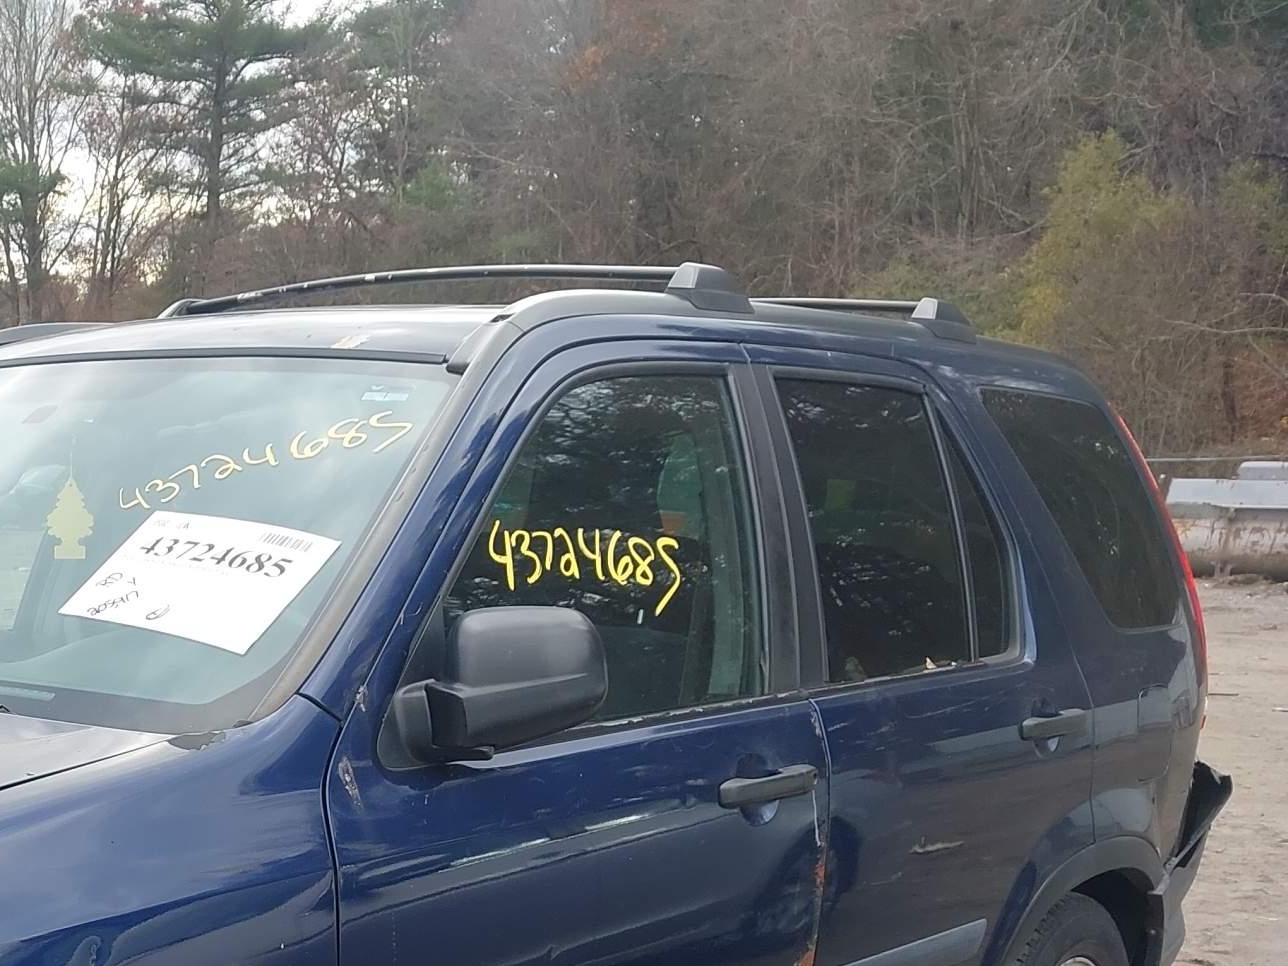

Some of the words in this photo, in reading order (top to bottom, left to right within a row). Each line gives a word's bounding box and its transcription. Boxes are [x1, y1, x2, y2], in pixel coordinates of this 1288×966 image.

[119, 411, 413, 511] 43724685
[140, 537, 293, 577] 43724685
[489, 520, 681, 616] 43724685
